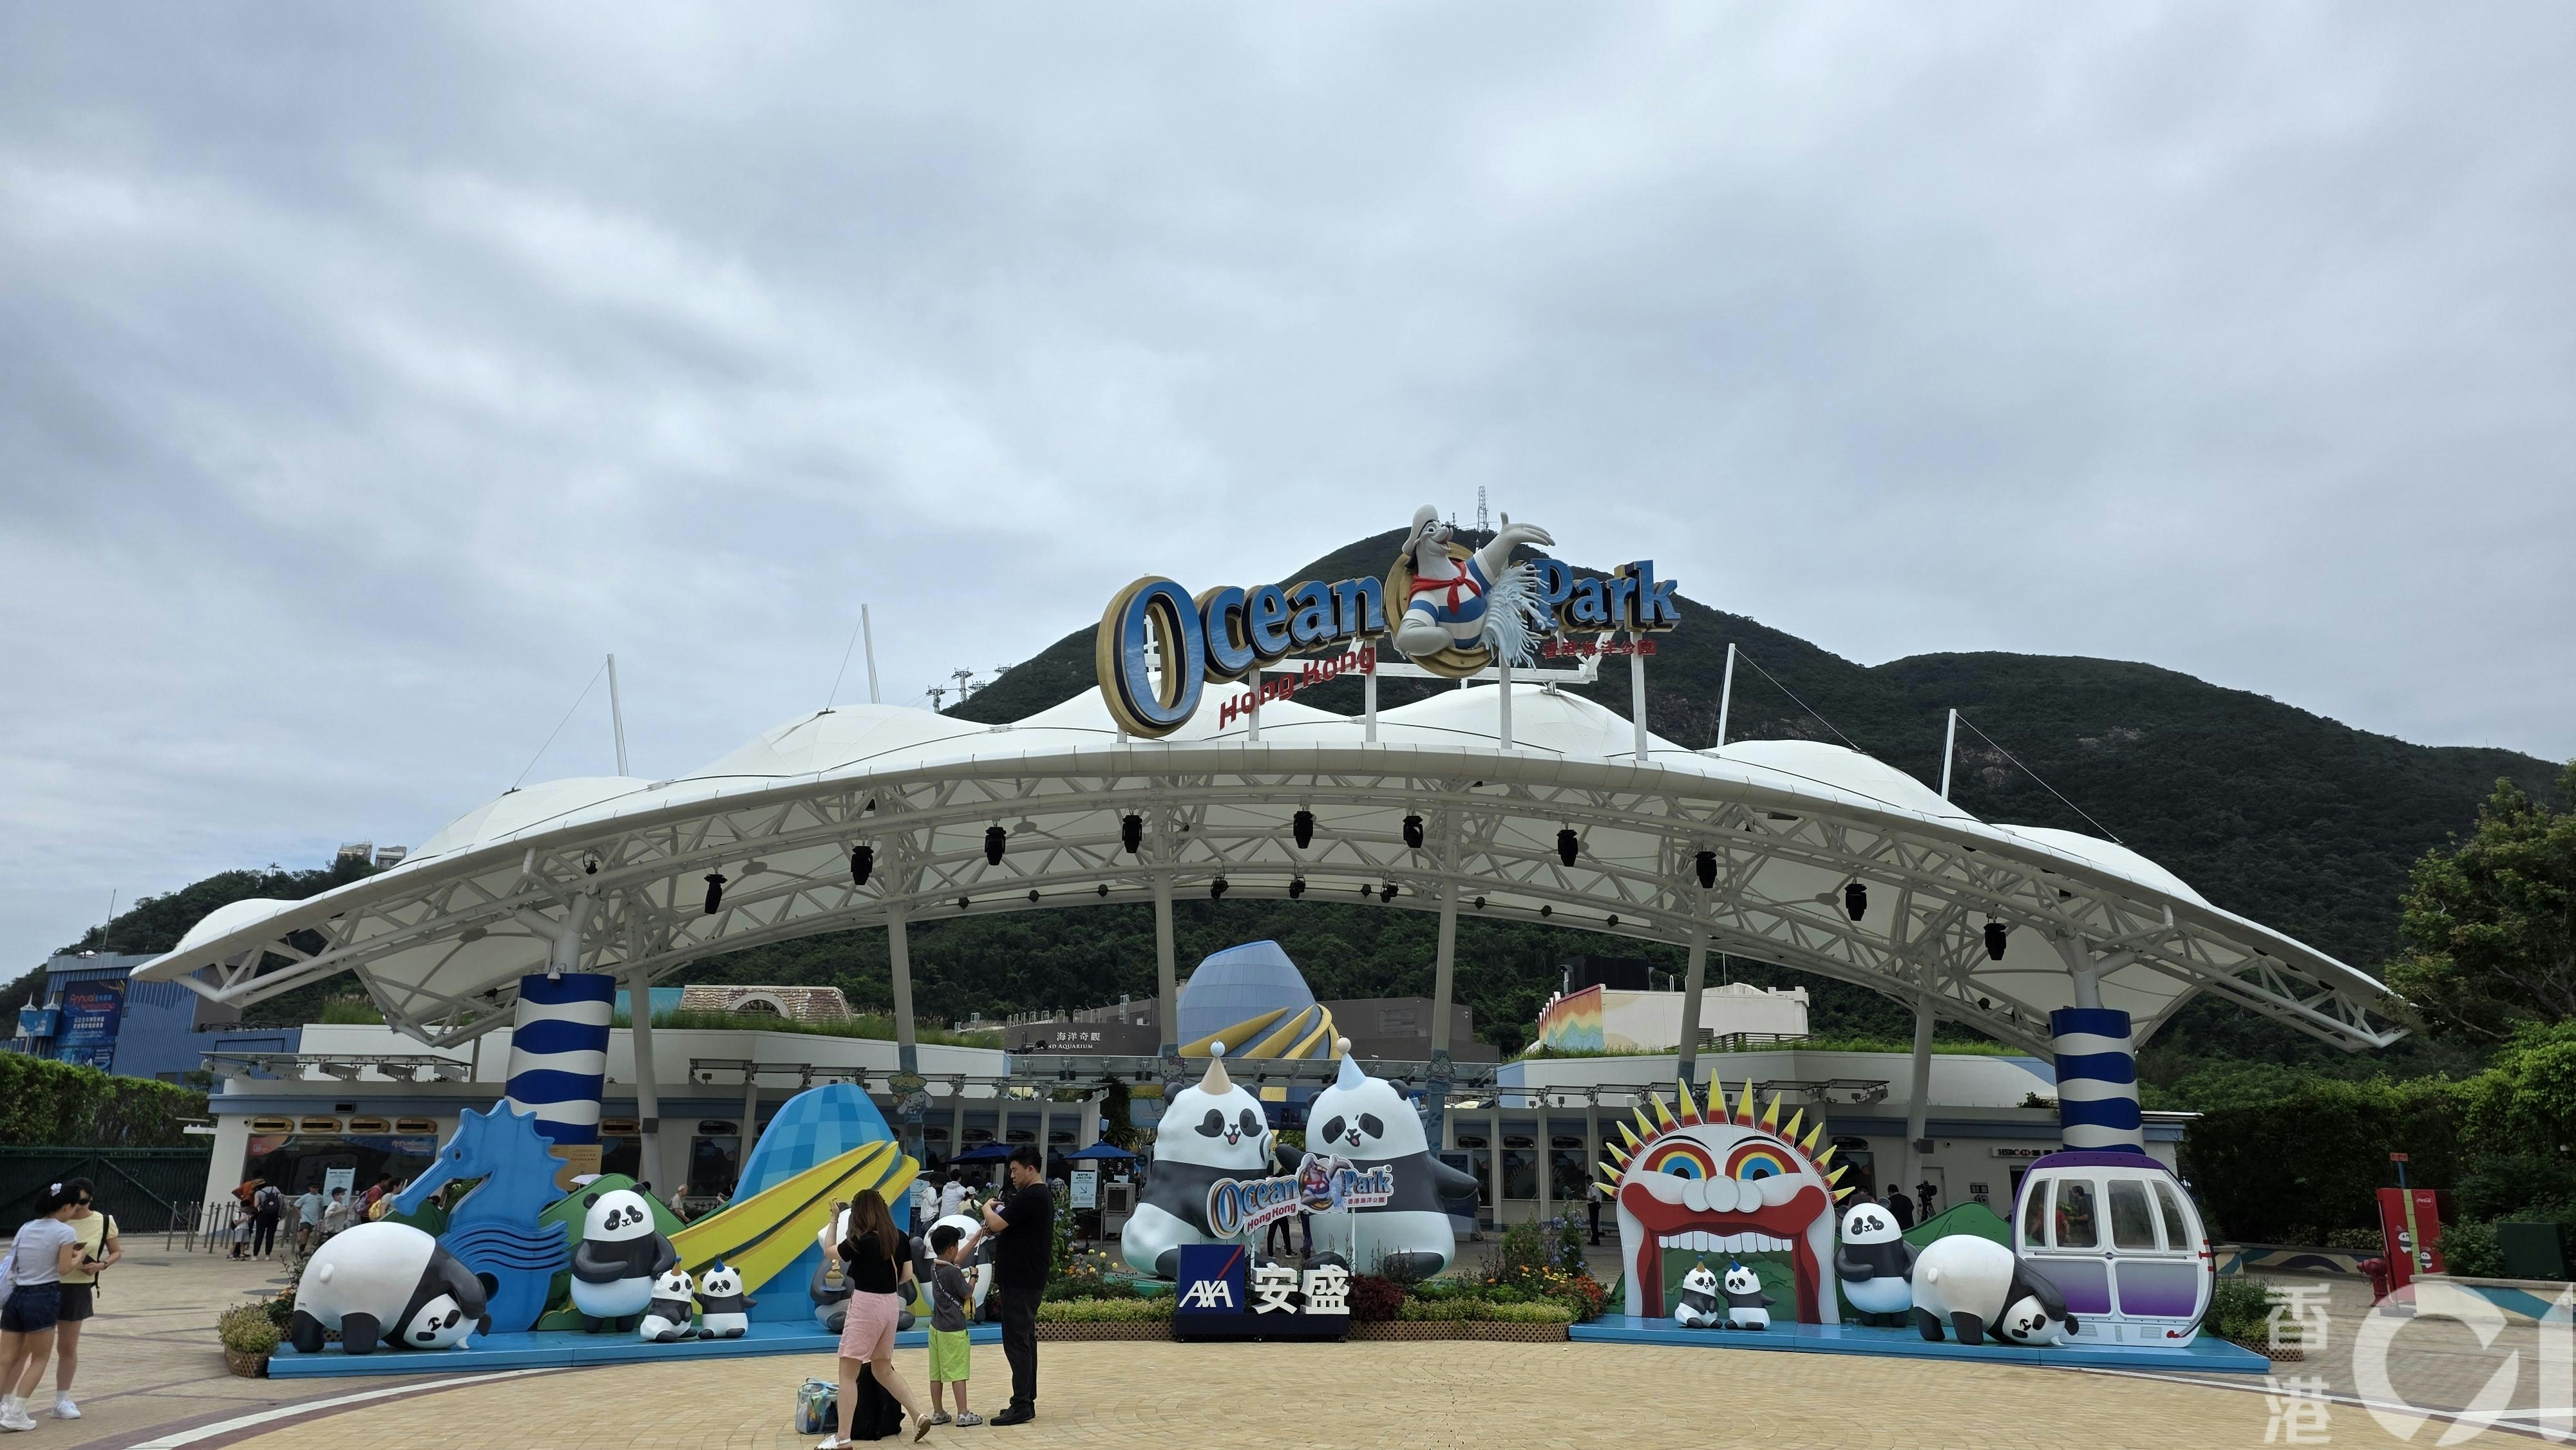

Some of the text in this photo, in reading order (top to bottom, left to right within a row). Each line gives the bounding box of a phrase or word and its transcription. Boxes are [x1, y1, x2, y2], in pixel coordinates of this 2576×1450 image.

[1096, 558, 1681, 738] Ocean Park
[1542, 639, 1656, 658] 香港海洋公園
[1219, 646, 1375, 731] Hong Kong
[1056, 1031, 1101, 1041] 海洋奇觀
[1211, 1170, 1391, 1235] Ocean Park
[1247, 1203, 1296, 1232] Hong Kong
[1179, 1280, 1234, 1308] AXA
[1251, 1262, 1350, 1314] 安盛
